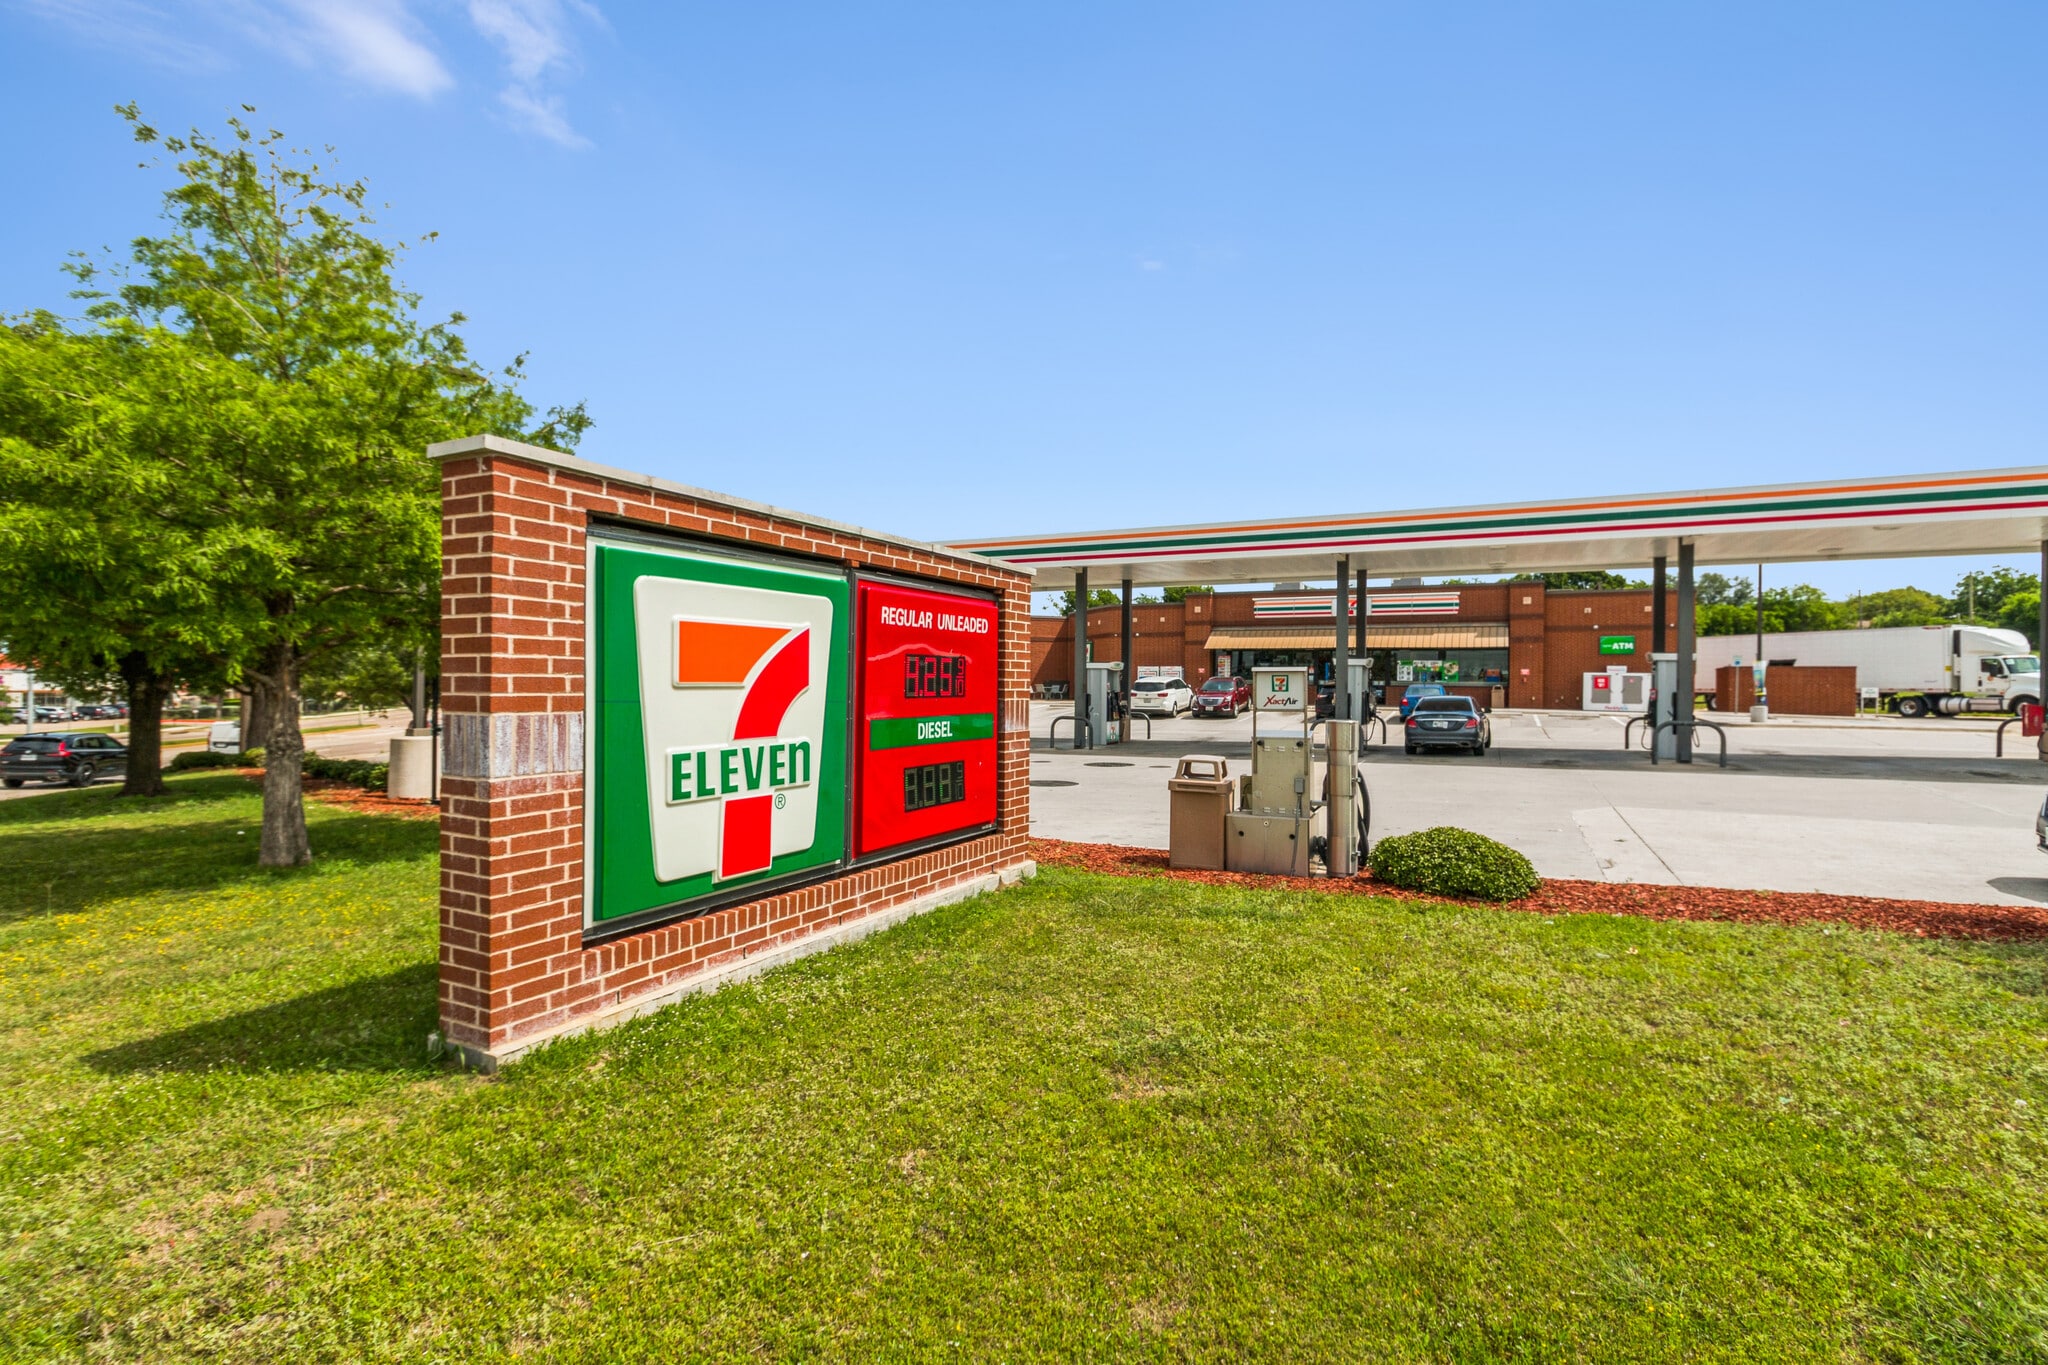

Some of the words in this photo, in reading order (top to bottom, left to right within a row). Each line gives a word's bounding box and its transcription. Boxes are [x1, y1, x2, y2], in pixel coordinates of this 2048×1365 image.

[881, 606, 933, 630] REGULAR
[937, 613, 989, 634] UNLEADED
[1611, 642, 1634, 650] ATM
[906, 656, 953, 697] 4.25
[1263, 694, 1299, 707] XactAir
[917, 720, 953, 740] DIESEL
